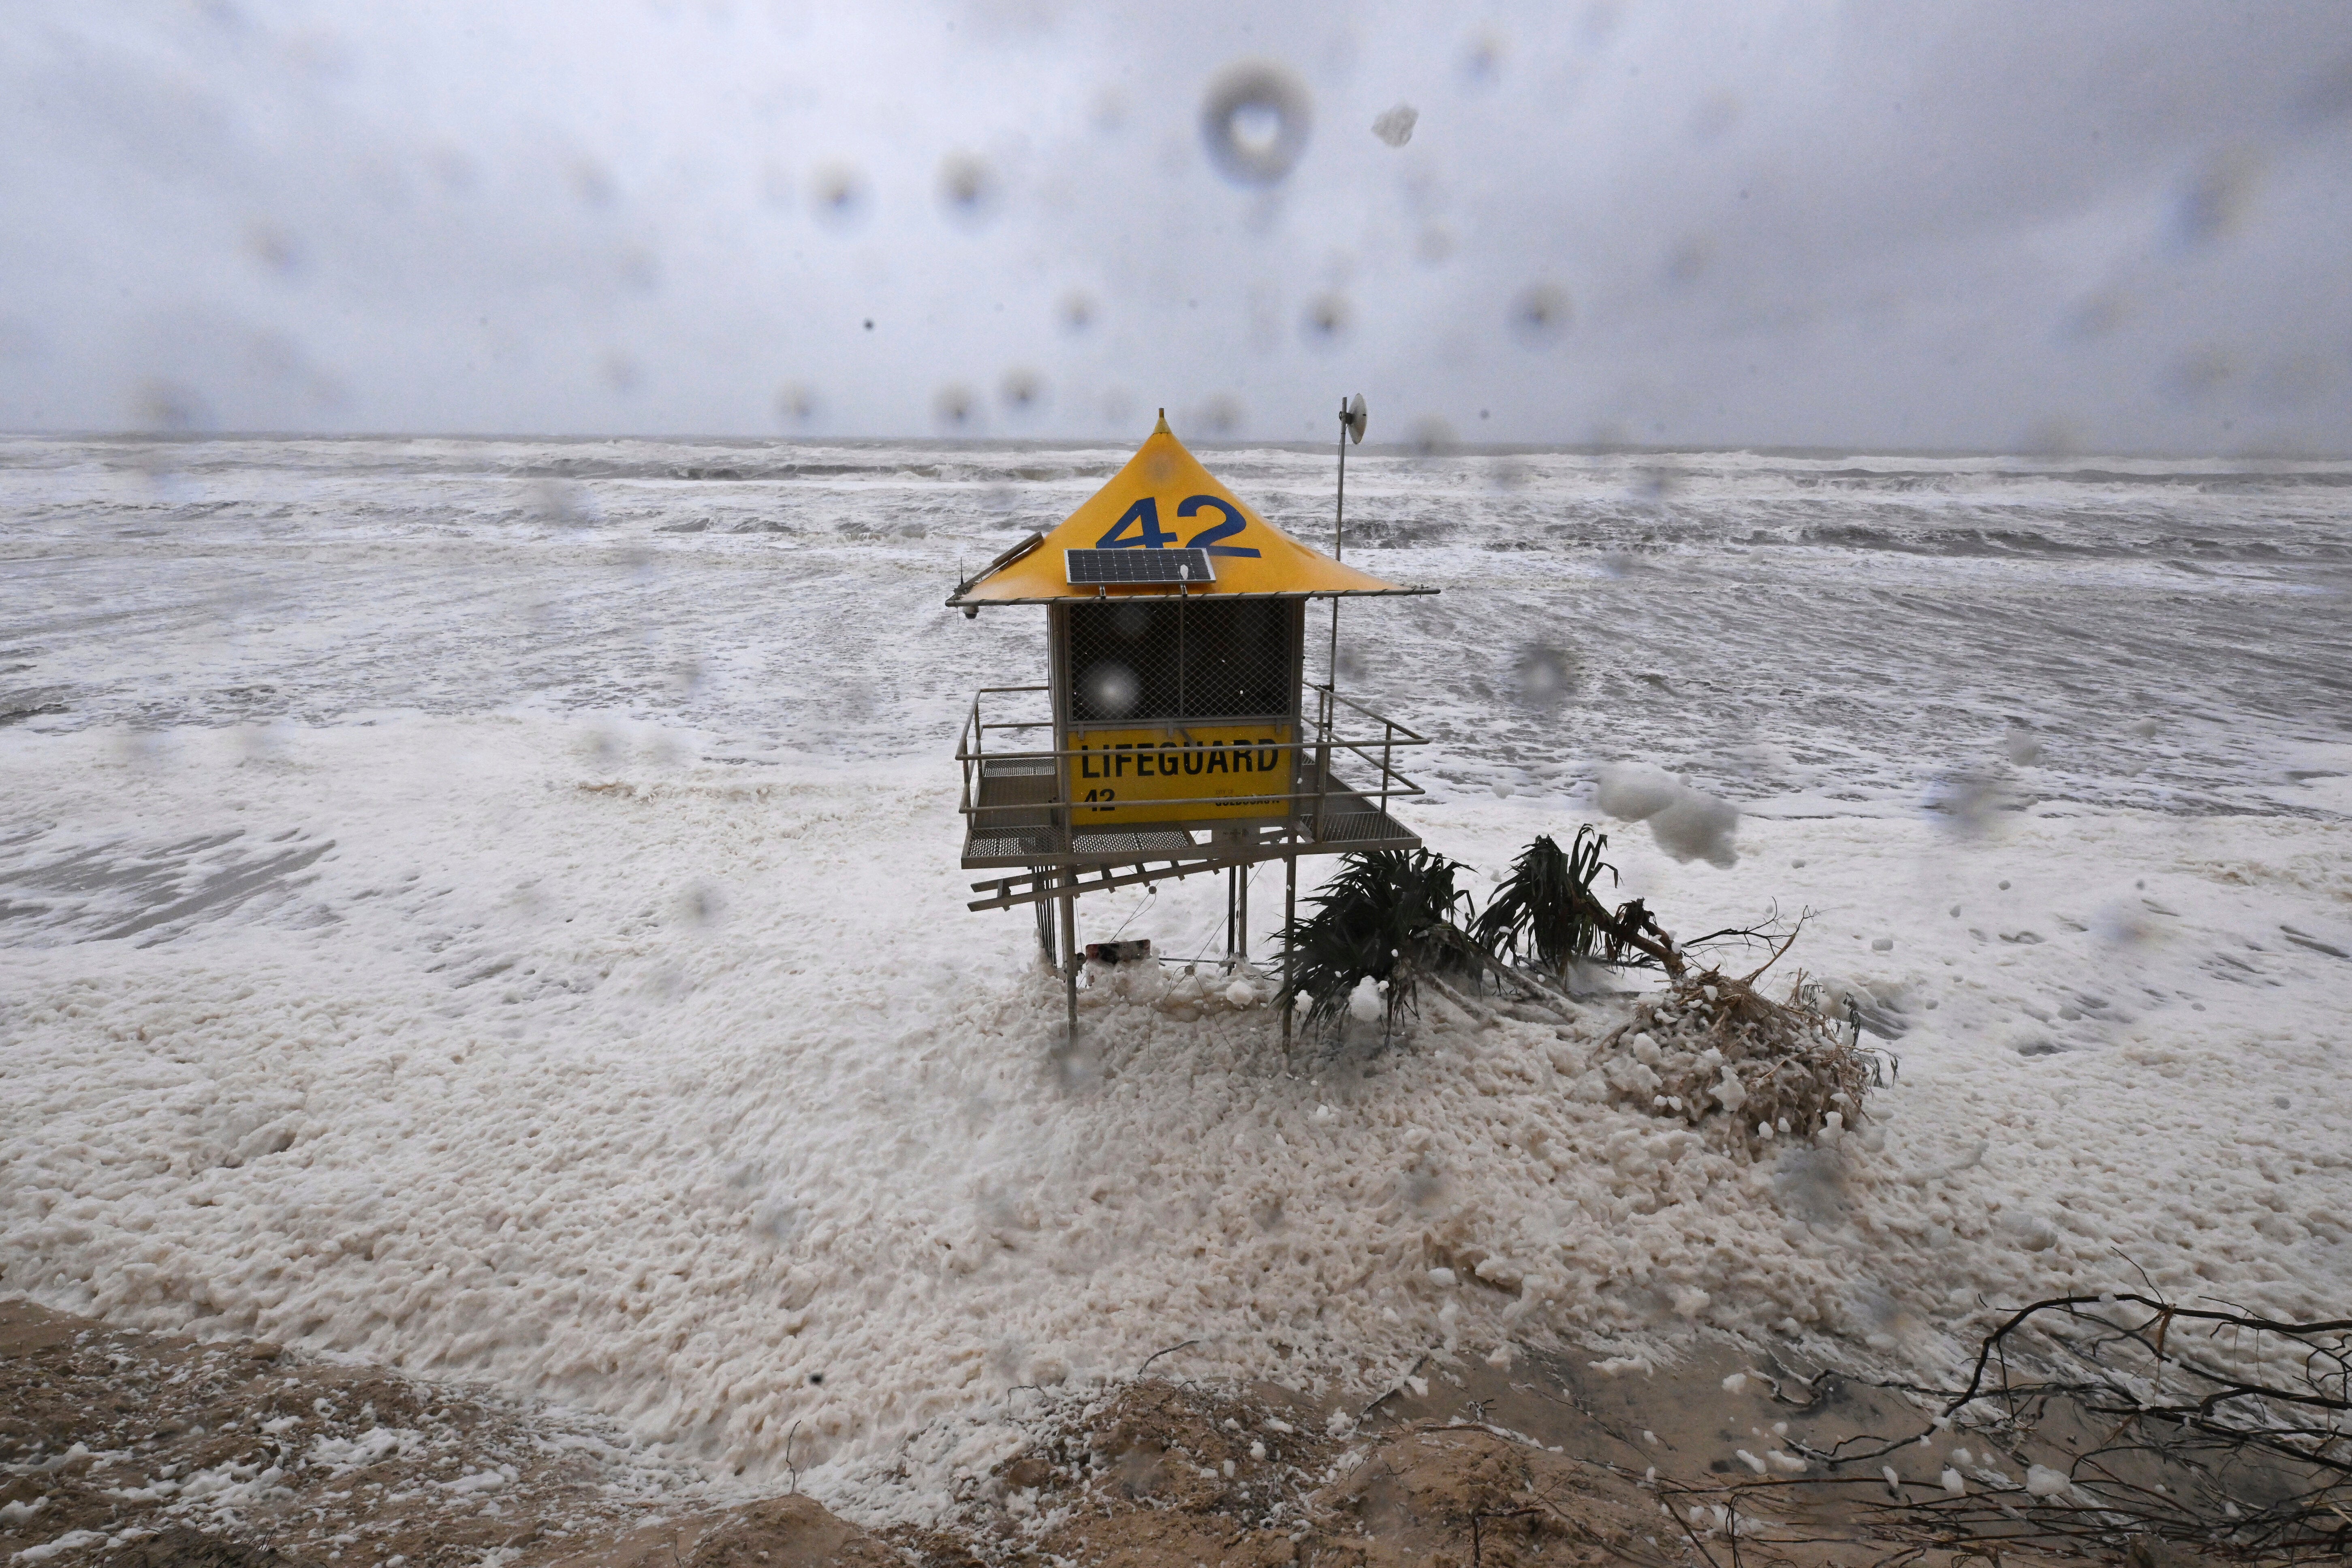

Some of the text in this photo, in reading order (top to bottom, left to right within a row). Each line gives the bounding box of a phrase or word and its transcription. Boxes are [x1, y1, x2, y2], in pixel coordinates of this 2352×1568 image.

[1096, 495, 1261, 558] 42
[1081, 738, 1279, 778] LIFEGUARD
[1084, 789, 1115, 811] 42
